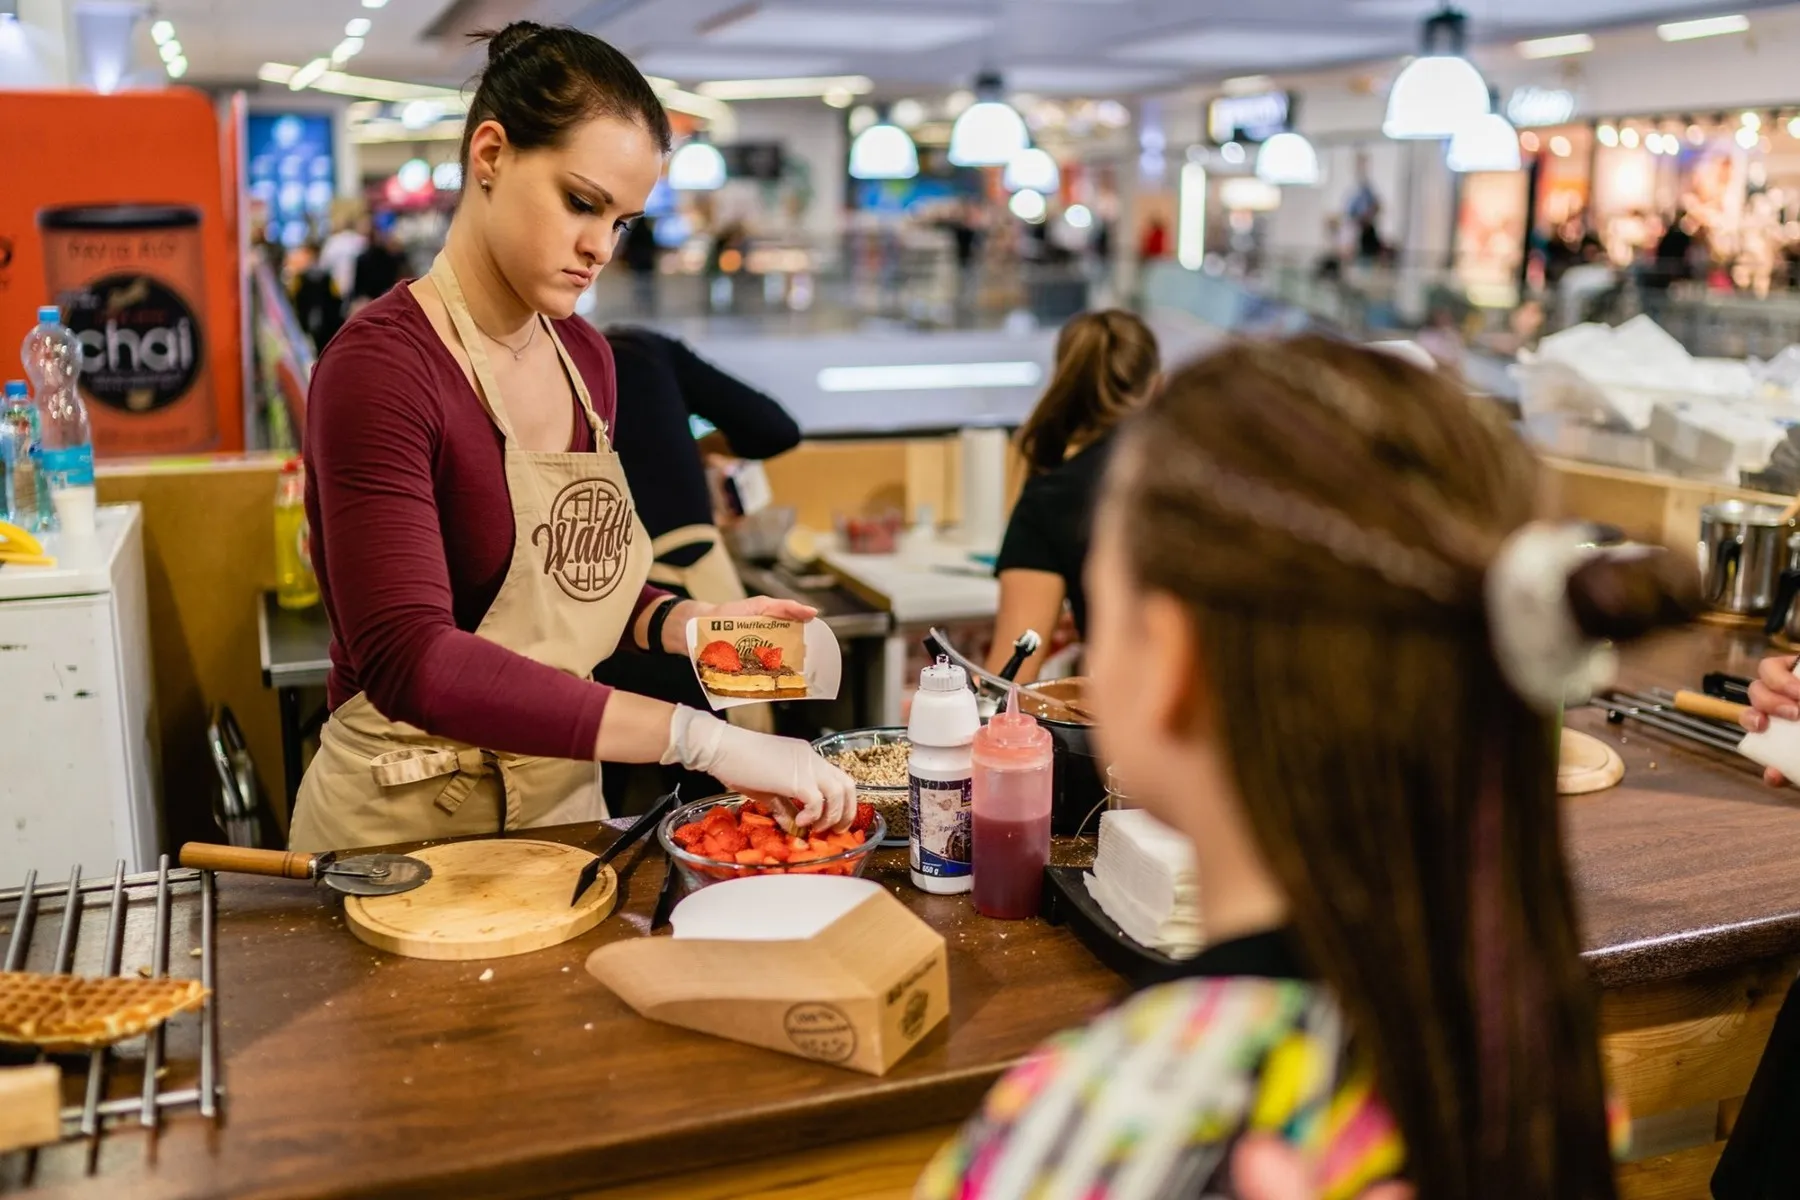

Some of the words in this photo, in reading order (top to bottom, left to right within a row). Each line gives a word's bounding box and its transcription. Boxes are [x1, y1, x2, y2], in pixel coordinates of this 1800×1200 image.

[75, 316, 194, 373] chai
[531, 498, 634, 575] Waffle
[736, 620, 791, 630] WaffleczBrno
